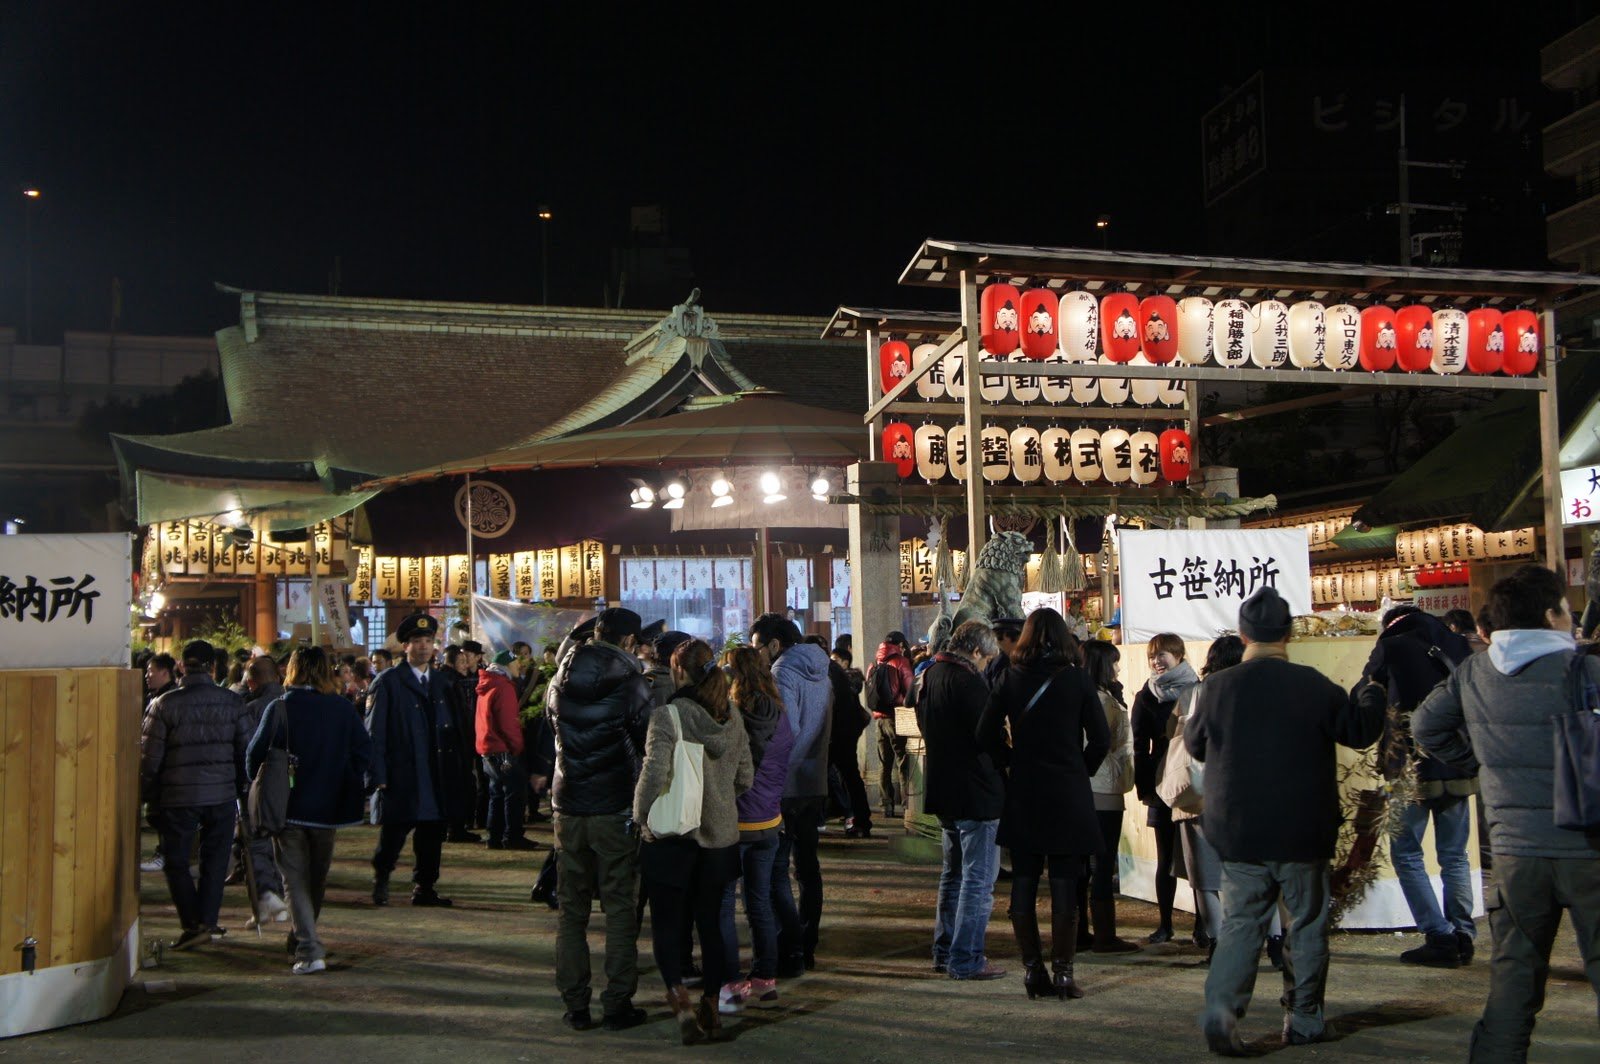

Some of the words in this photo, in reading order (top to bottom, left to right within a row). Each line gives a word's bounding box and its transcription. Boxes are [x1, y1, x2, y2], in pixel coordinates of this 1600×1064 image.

[1571, 497, 1591, 519] お
[382, 557, 396, 597] ヒビール
[1148, 555, 1280, 601] 古笹納所
